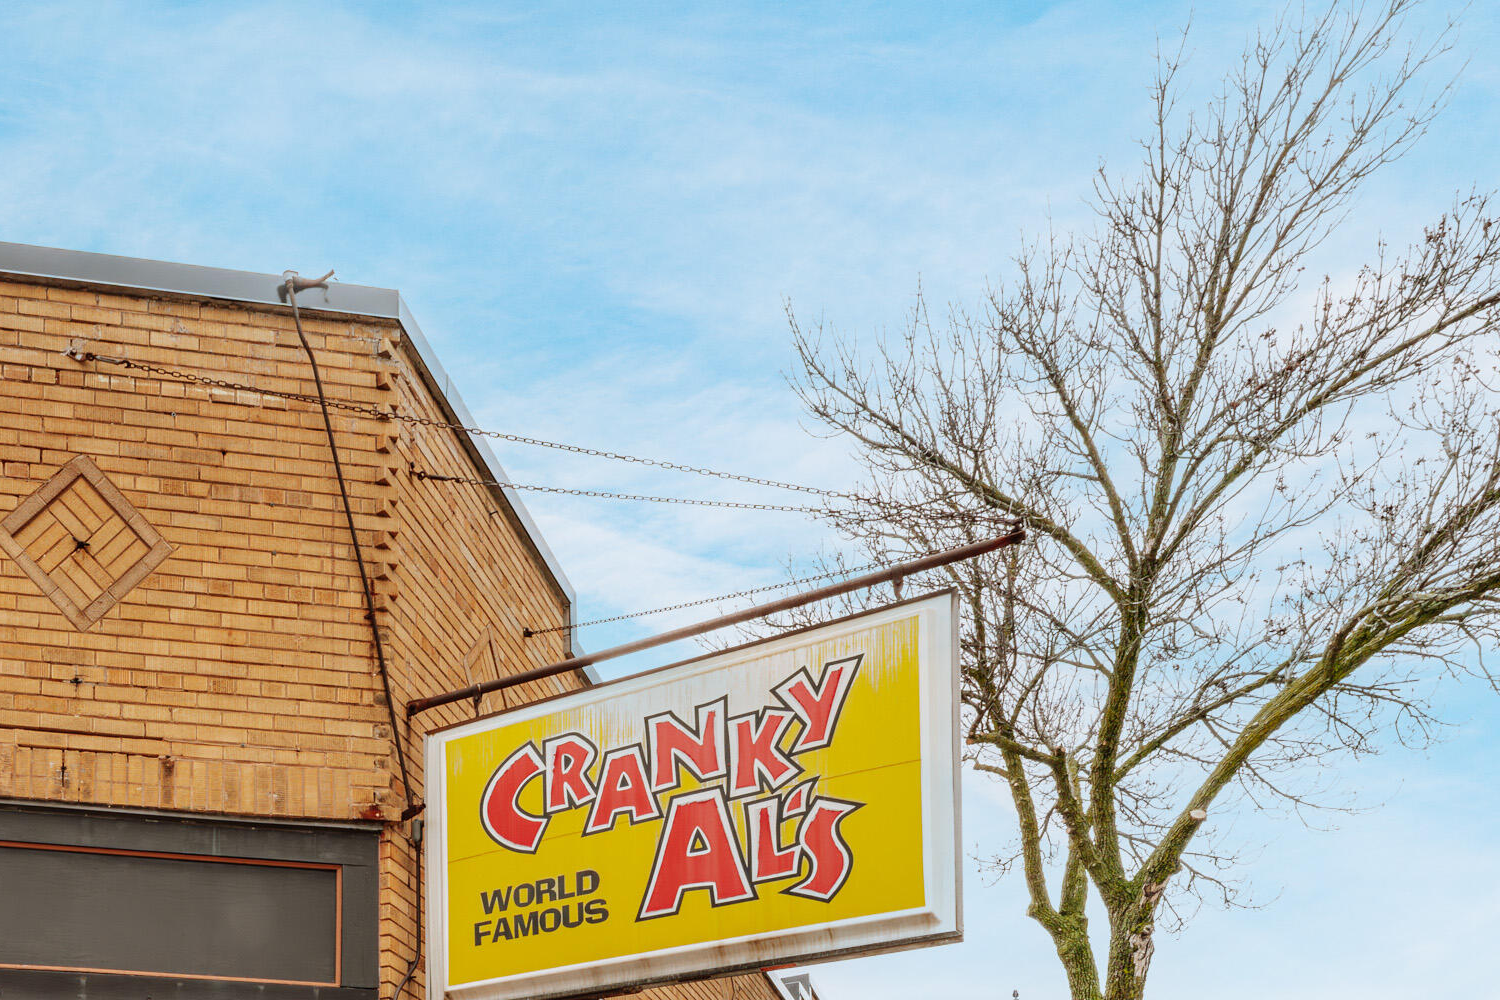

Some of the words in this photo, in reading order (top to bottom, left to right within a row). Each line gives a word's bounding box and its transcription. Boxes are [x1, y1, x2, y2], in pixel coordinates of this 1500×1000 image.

[480, 653, 864, 854] CRANKY
[480, 869, 600, 915] WORLD
[635, 776, 867, 922] AL'S
[473, 899, 609, 946] FAMOUS
